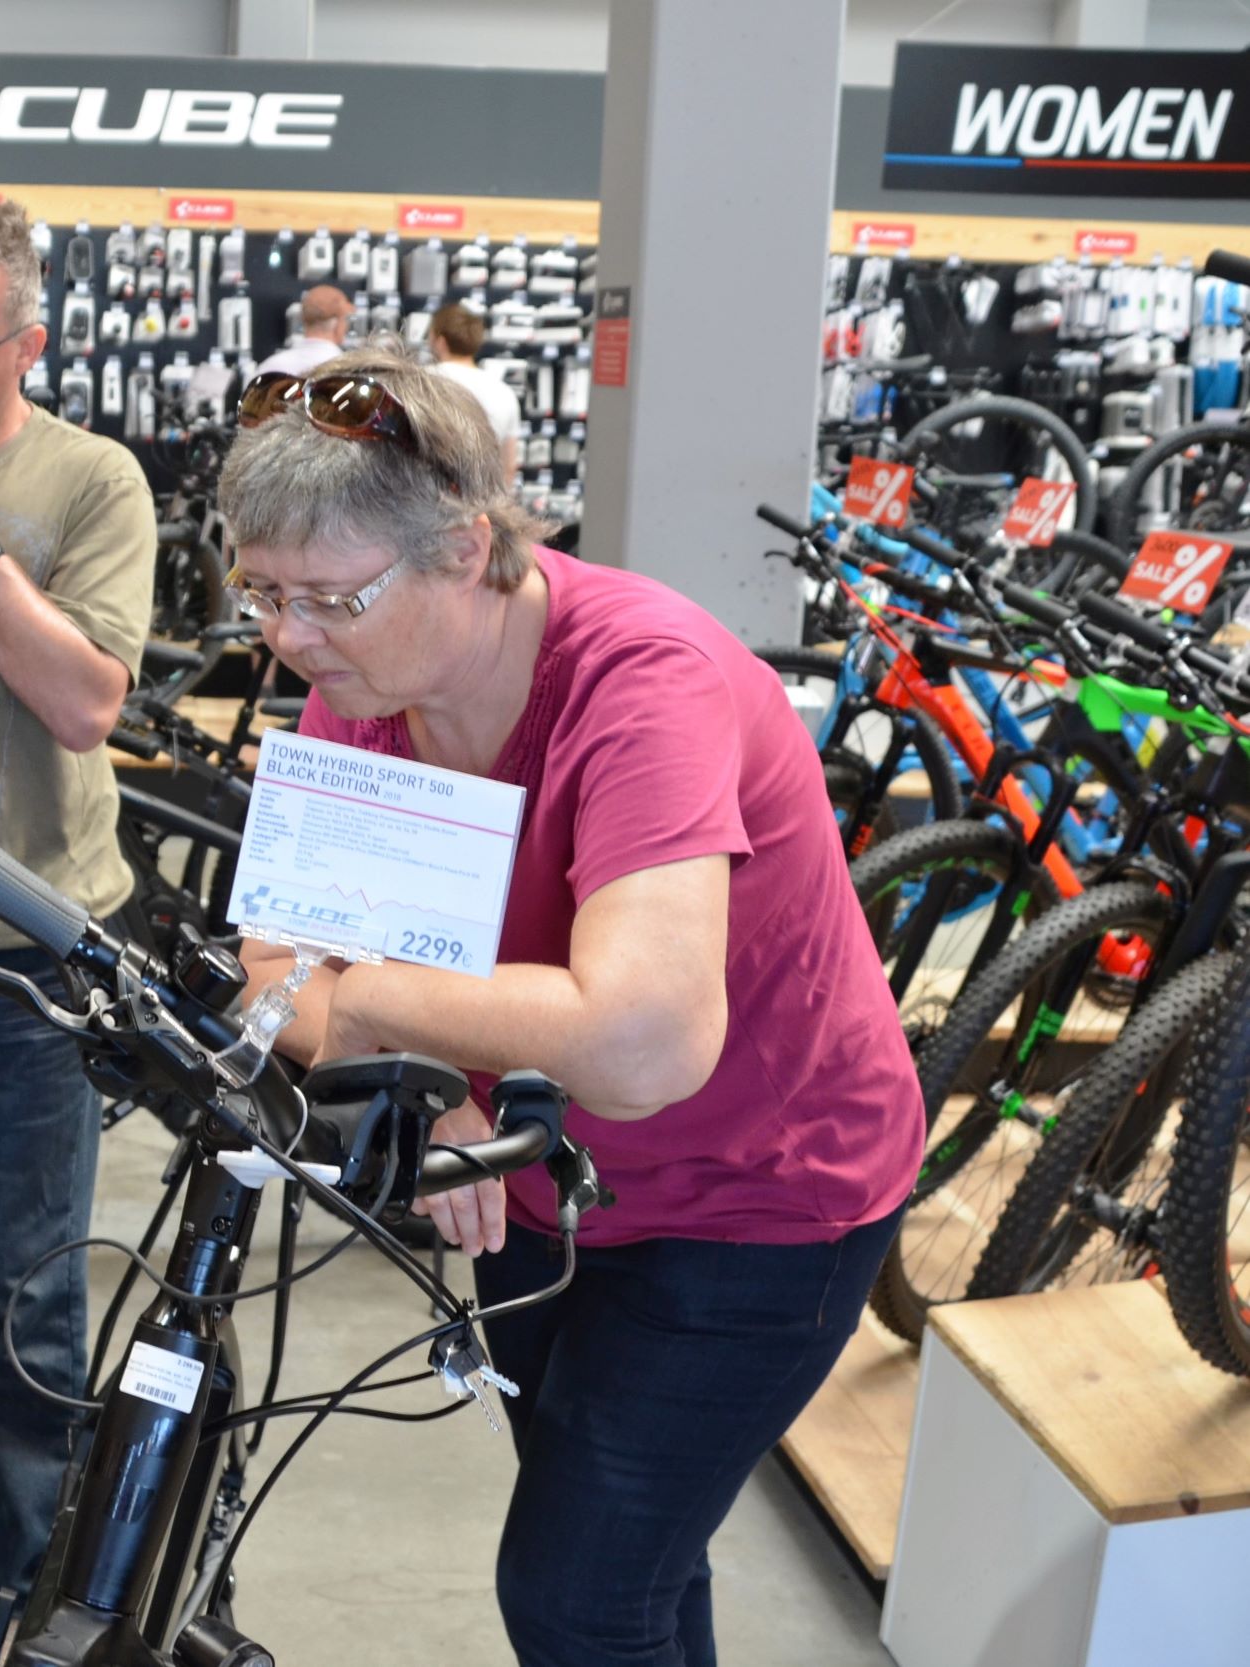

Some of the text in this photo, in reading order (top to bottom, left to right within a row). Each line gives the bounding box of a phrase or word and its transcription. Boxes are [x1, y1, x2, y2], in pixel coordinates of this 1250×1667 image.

[951, 82, 1234, 162] WOMEN
[848, 483, 878, 501] SALE
[1012, 507, 1040, 523] SALE
[1133, 560, 1177, 584] SALE
[266, 759, 317, 782] BLACK
[321, 772, 380, 797] EDITION
[269, 743, 454, 797] TOWN HYBRID SPORT 500
[269, 897, 366, 929] CUBE
